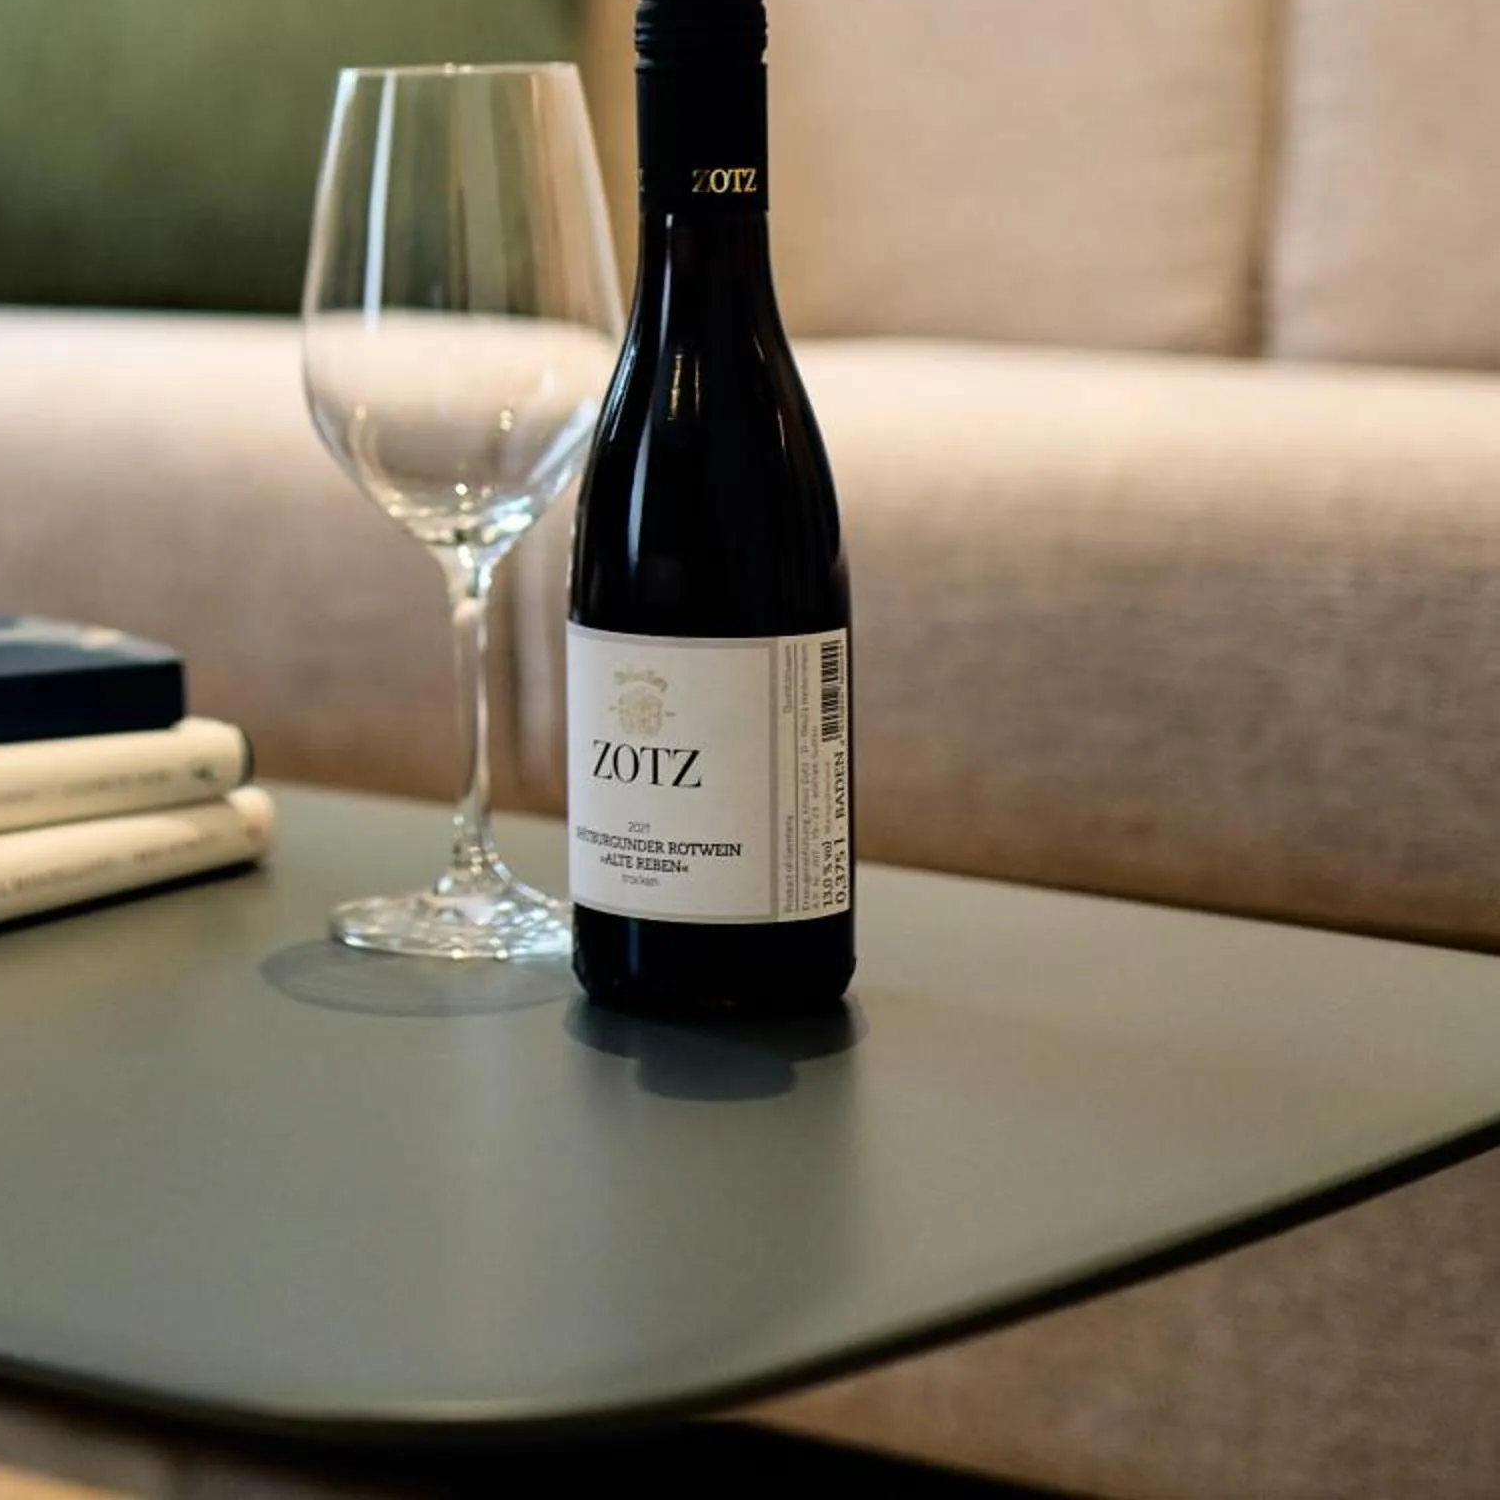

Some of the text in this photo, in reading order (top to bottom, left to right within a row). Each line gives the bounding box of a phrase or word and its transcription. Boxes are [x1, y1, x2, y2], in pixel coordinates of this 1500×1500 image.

[692, 168, 757, 193] ZOTZ
[593, 739, 703, 788] ZOTZ
[833, 751, 846, 819] BADEN
[668, 841, 742, 857] ROTWEIN
